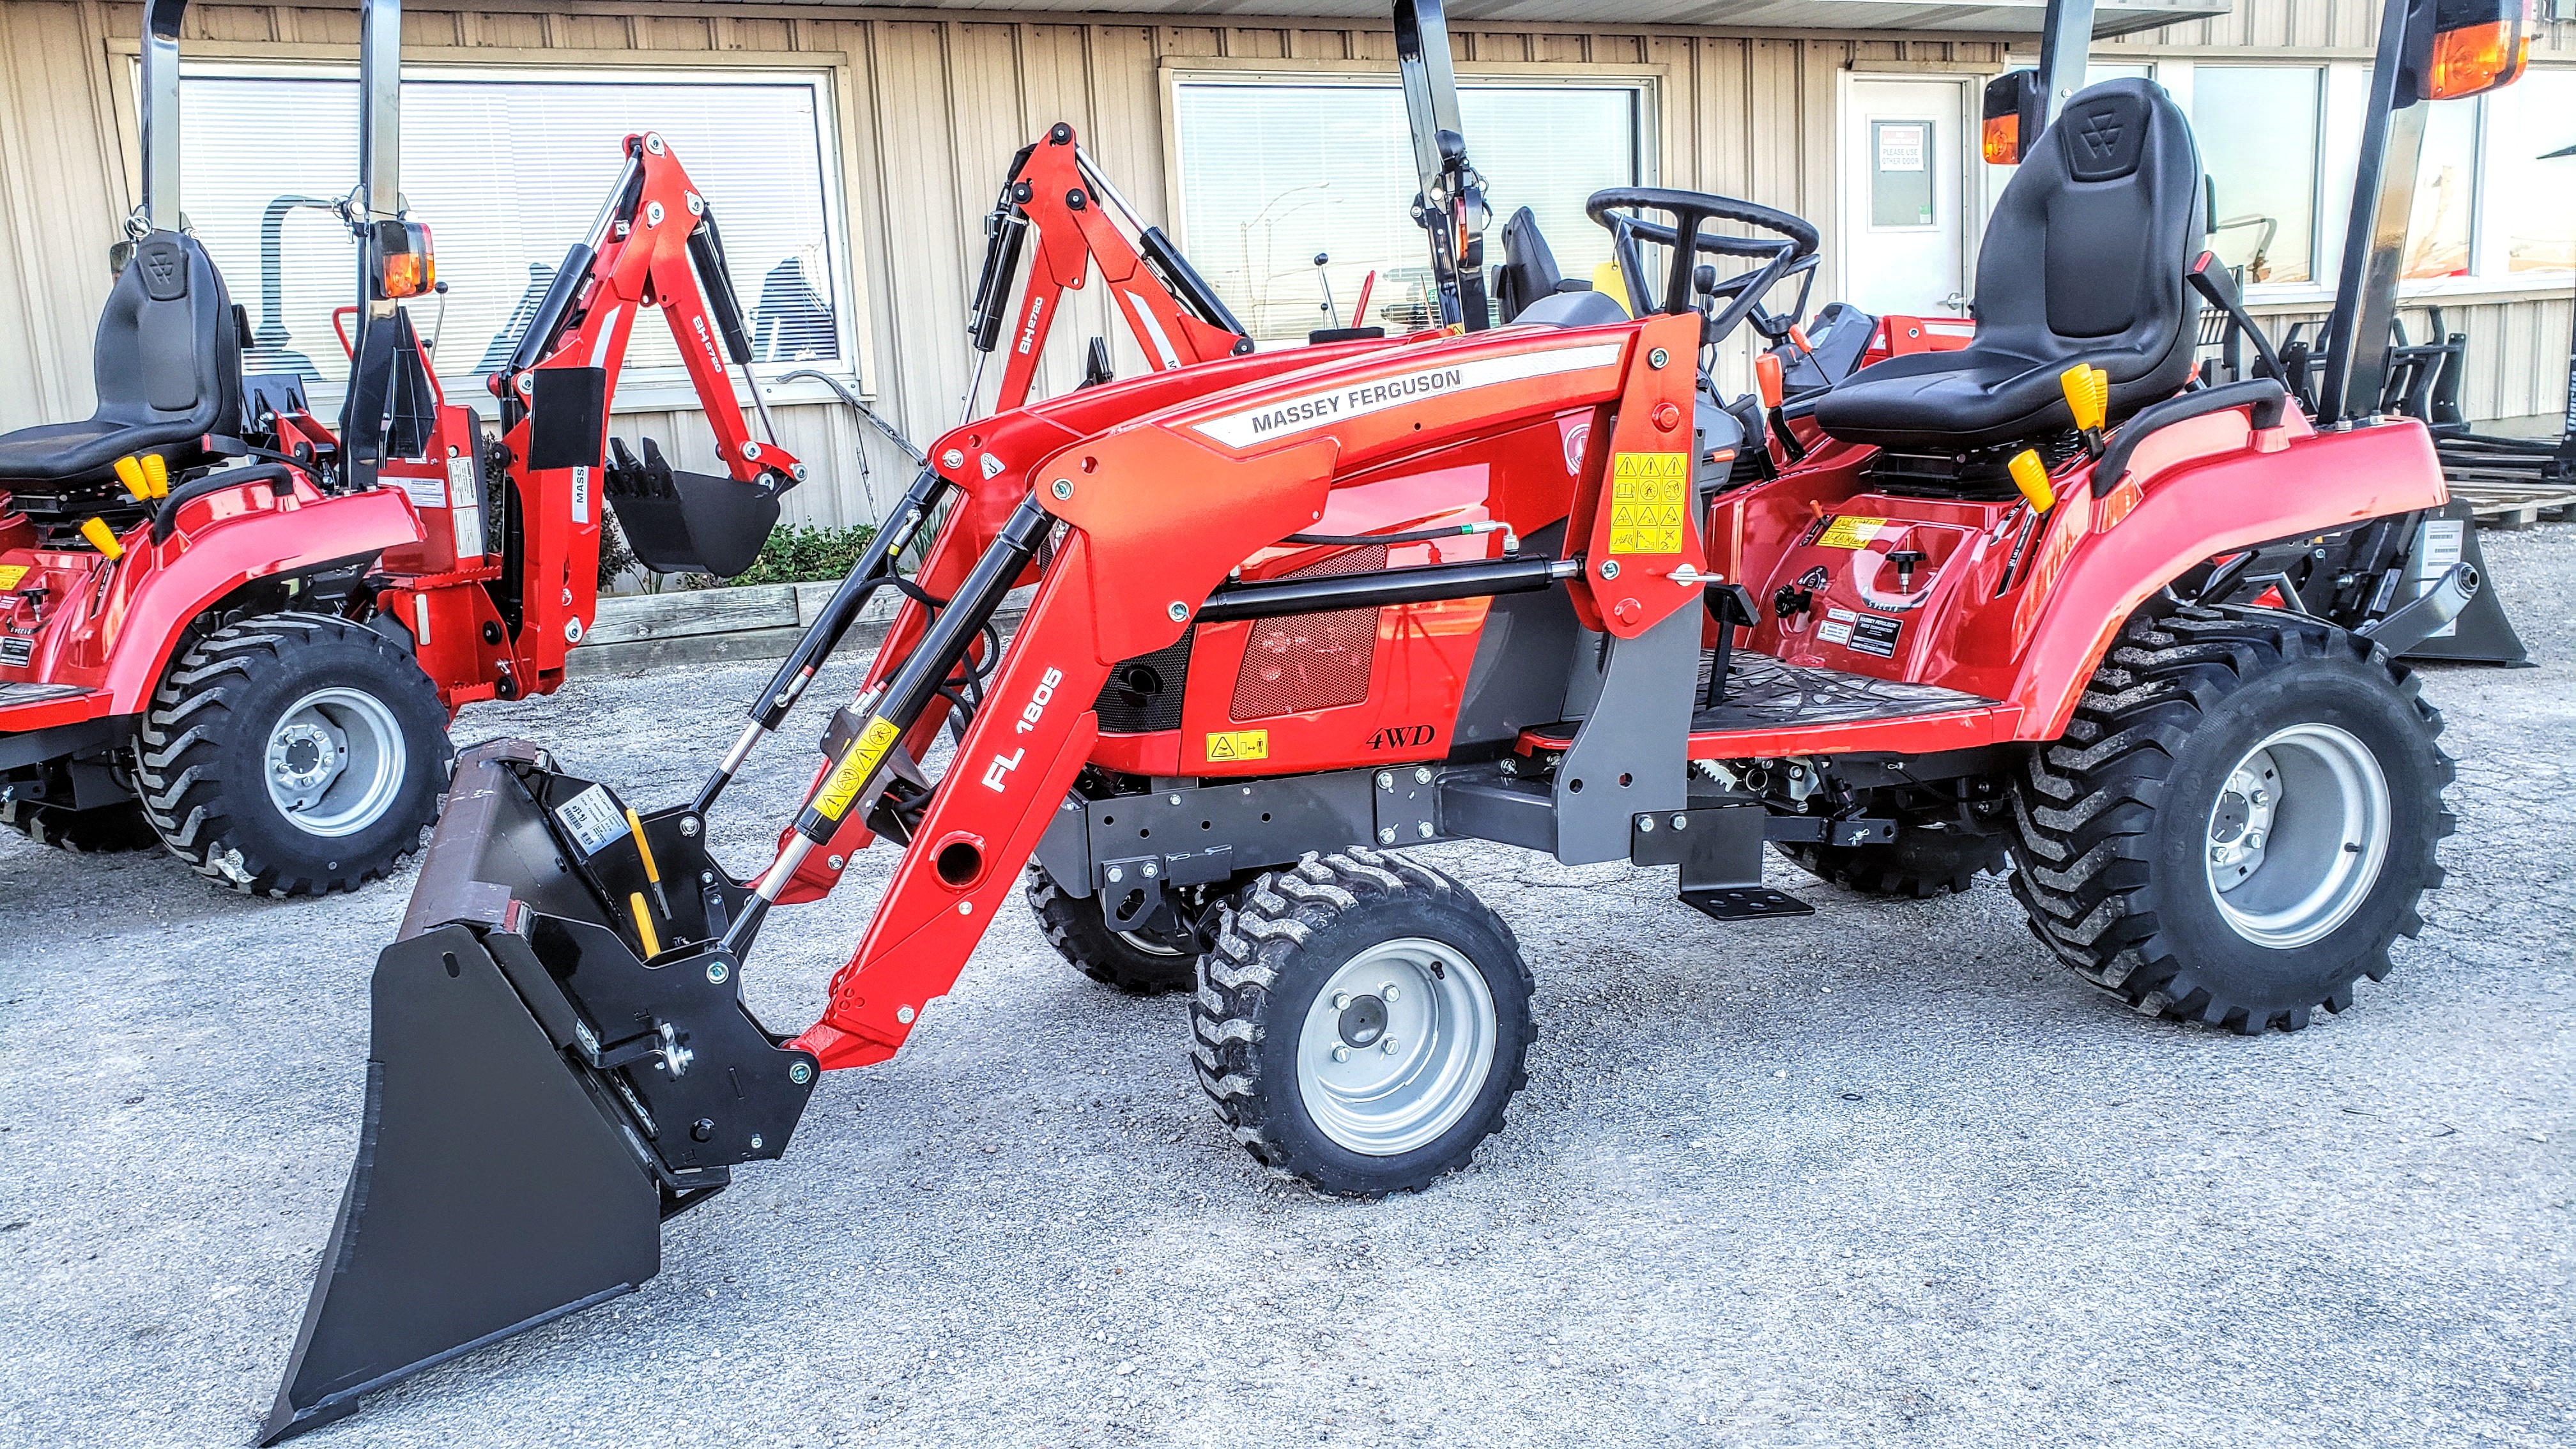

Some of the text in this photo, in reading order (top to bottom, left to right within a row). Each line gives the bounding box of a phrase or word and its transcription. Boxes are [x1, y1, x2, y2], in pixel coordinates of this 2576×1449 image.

[1252, 370, 1461, 434] MASSEY FERGUSON
[981, 666, 1063, 793] FL 1805
[1365, 724, 1436, 750] 4WD
